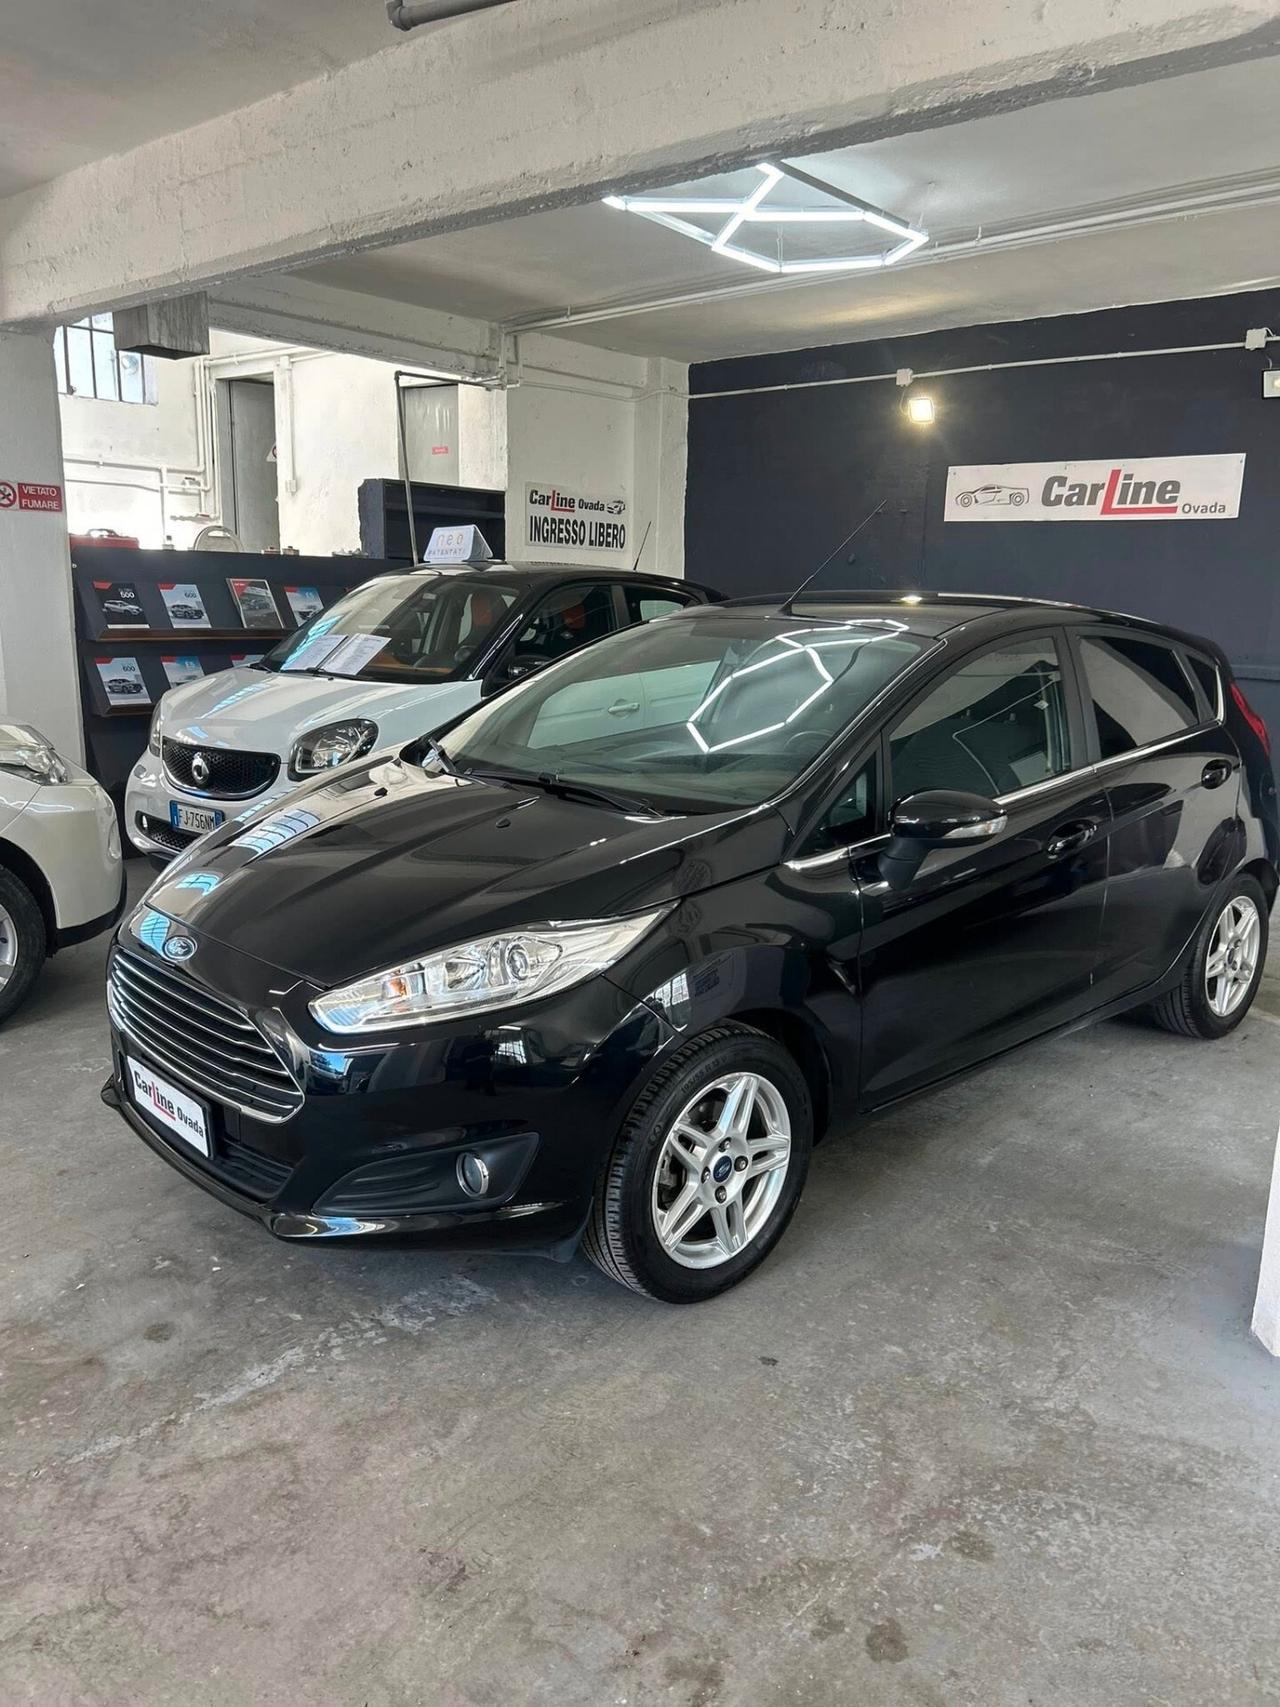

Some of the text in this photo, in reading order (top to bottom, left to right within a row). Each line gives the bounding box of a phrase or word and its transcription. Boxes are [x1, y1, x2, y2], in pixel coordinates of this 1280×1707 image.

[22, 485, 57, 497] VIETATO
[22, 498, 60, 510] FUMARE
[529, 489, 606, 512] CarLine Ovada
[1041, 469, 1226, 515] CarLine Ovada
[529, 515, 626, 549] INGRESSO LIBERO
[134, 1070, 204, 1138] CarLine Ovada
